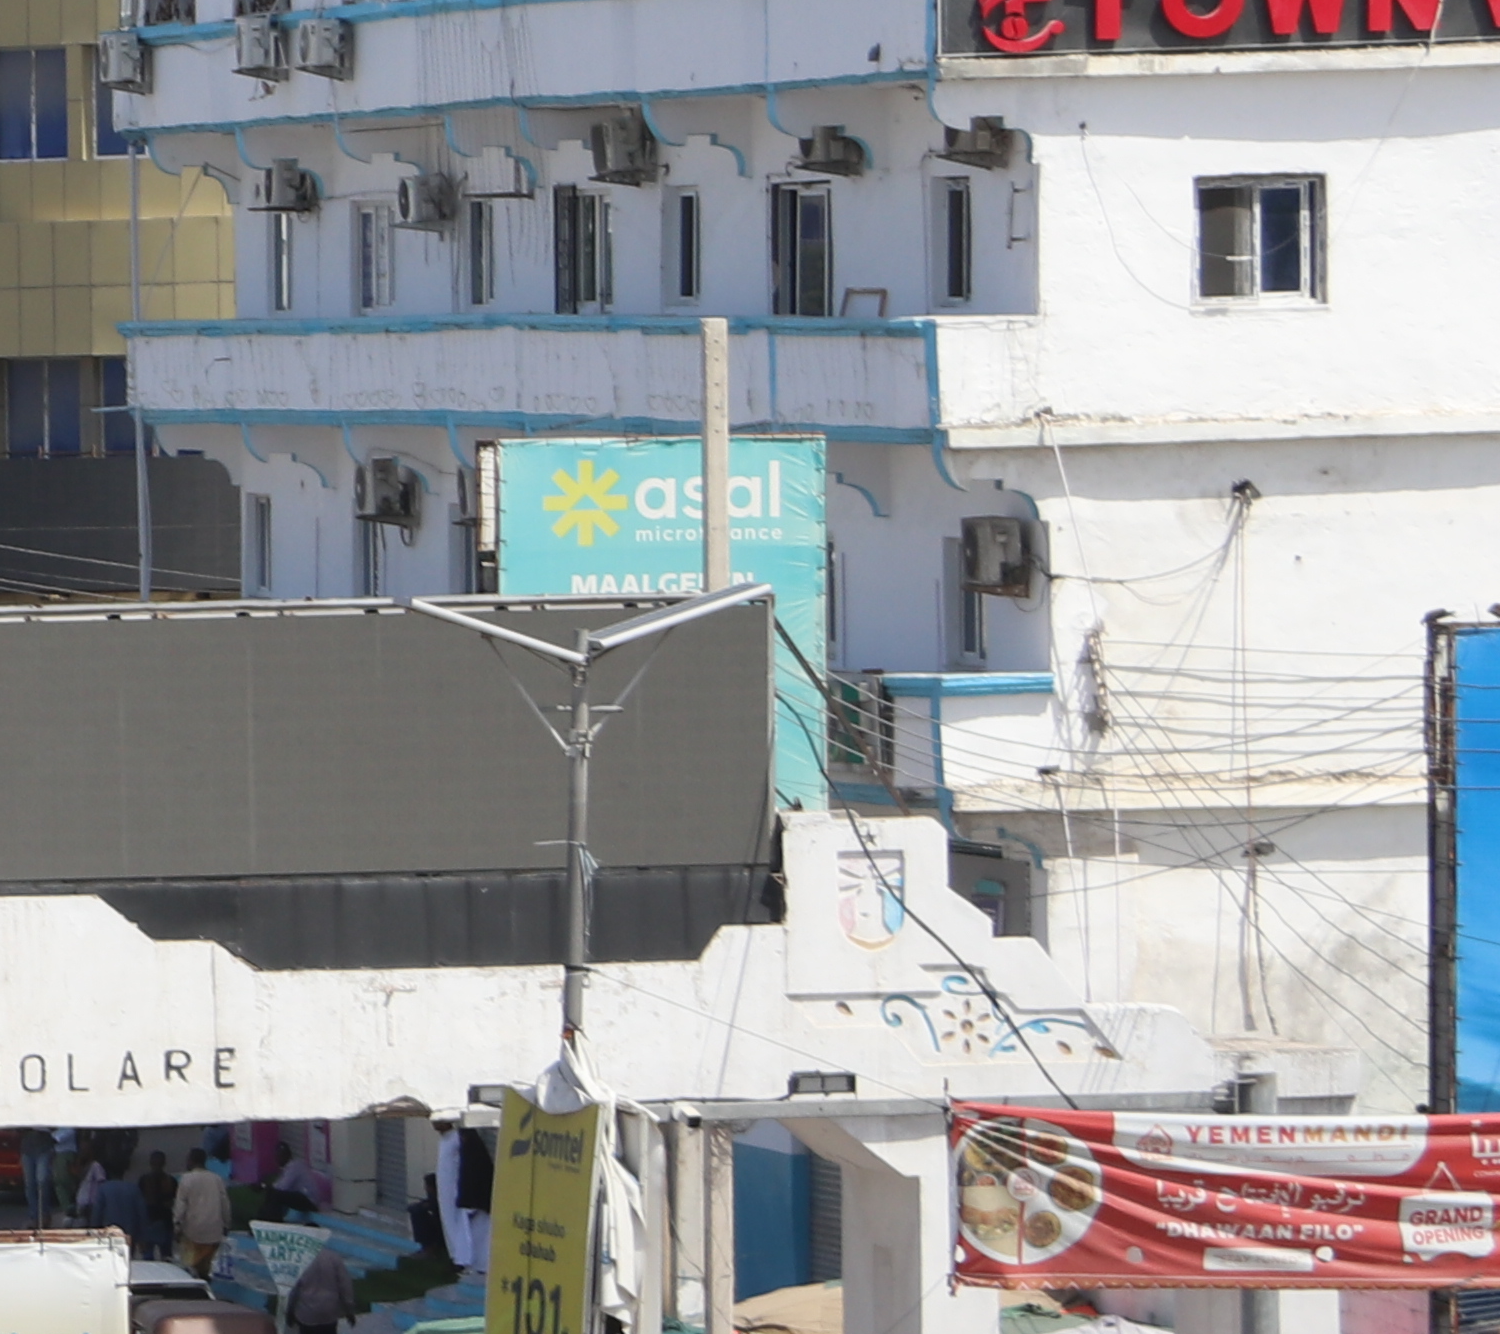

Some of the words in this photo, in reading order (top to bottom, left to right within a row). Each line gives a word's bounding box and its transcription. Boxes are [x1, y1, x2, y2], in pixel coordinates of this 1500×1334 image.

[634, 459, 782, 520] asal
[534, 1128, 585, 1164] somtel
[1409, 1206, 1485, 1227] GRAND
[1300, 1223, 1364, 1241] FILO"
[1412, 1224, 1485, 1247] OPENING
